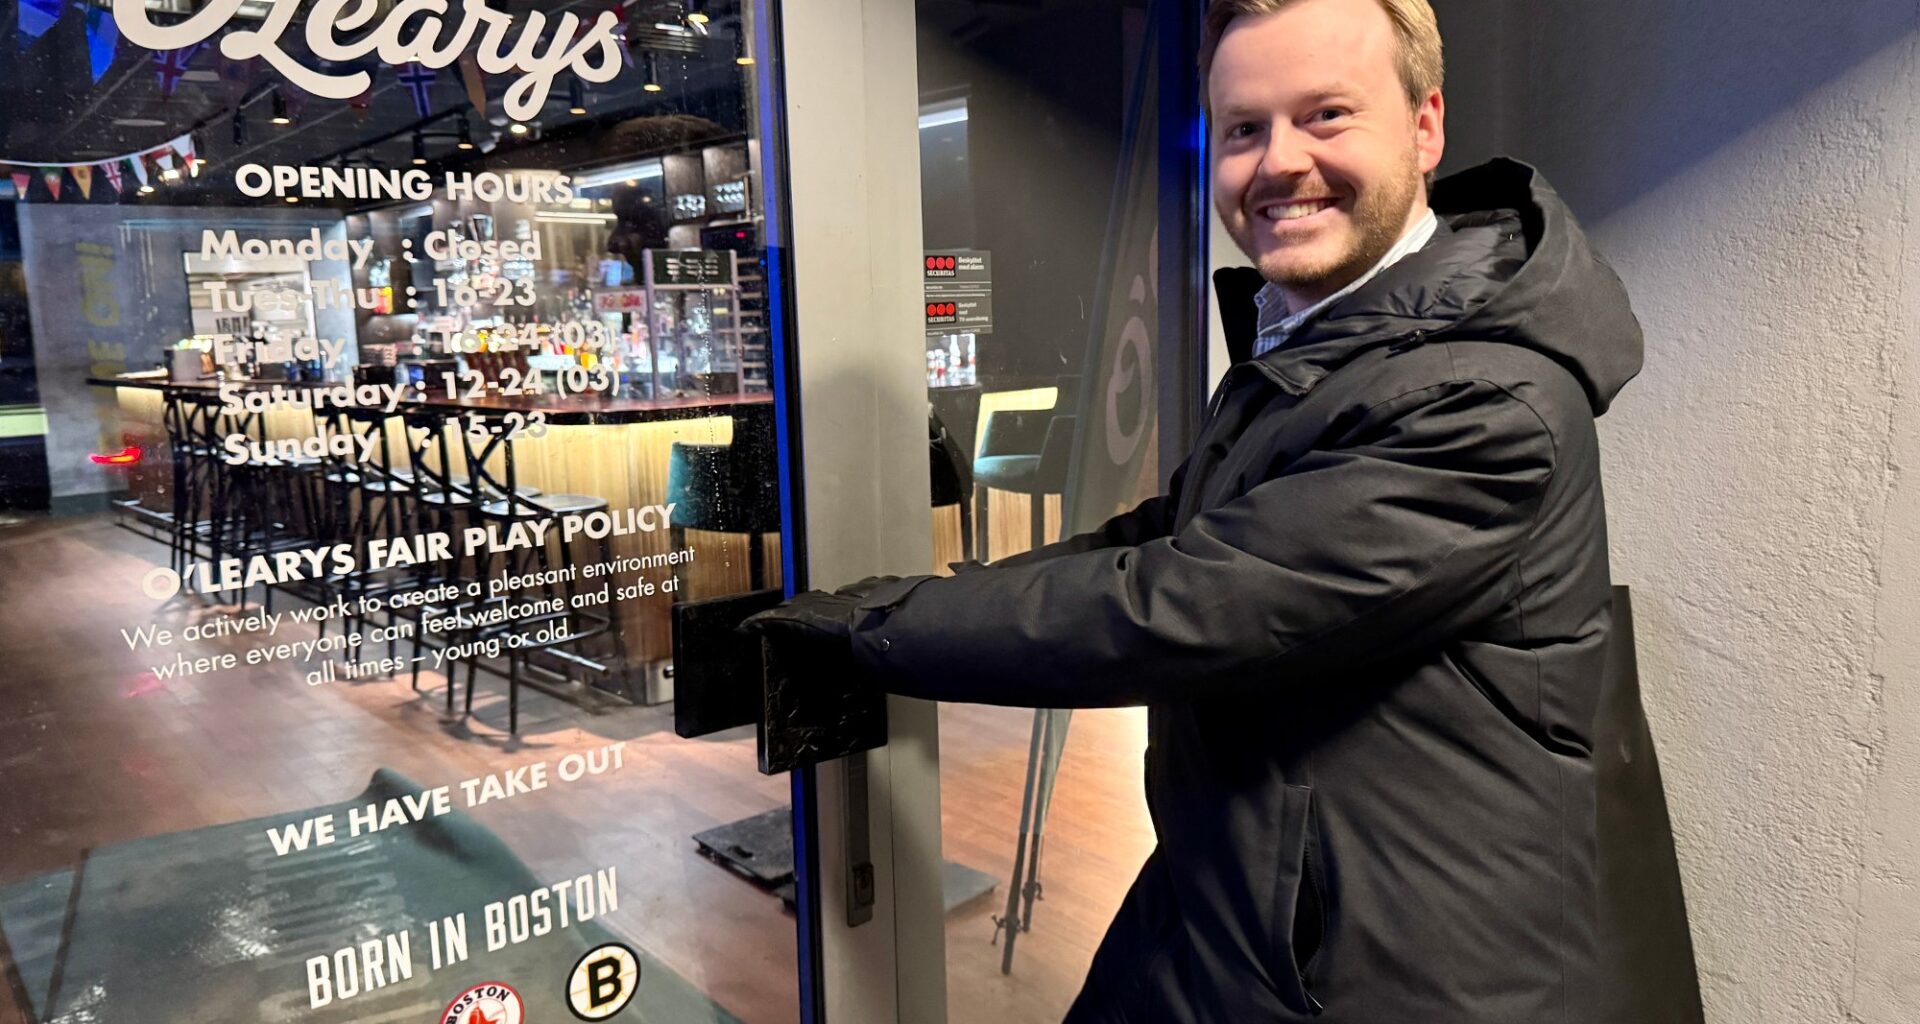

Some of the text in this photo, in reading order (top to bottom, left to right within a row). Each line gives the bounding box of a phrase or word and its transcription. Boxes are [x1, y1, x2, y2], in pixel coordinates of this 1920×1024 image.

[113, 0, 623, 122] Learys
[235, 163, 573, 203] OPENING HOURS
[201, 228, 375, 270] Monday
[424, 228, 542, 261] Closed
[927, 269, 955, 277] SECURITAS
[433, 277, 537, 307] 16-23
[213, 330, 347, 368] Friday
[440, 322, 542, 354] 16-24
[554, 320, 616, 352] (03)
[928, 316, 956, 324] SECURITAS
[217, 375, 407, 416] Saturday
[441, 367, 544, 400] 12-24
[557, 364, 619, 400] (03)
[225, 425, 382, 466] Sunday
[446, 410, 548, 444] 15-23
[142, 503, 676, 600] O'LEARYS FAIR PLAY POLICY
[120, 545, 696, 652] We actively work to create a pleasant environment
[152, 575, 680, 681] where everyone can feel welcome and safe at
[306, 660, 336, 687] all
[344, 655, 405, 680] times
[432, 637, 500, 669] young
[508, 631, 530, 650] or
[536, 618, 575, 643] old.
[266, 741, 627, 857] WE HAVE TAKE OUT
[305, 929, 412, 1010] BORN
[429, 912, 468, 970] IN
[484, 866, 619, 952] BOSTON
[445, 985, 511, 1024] BOSTON
[587, 954, 623, 1009] B
